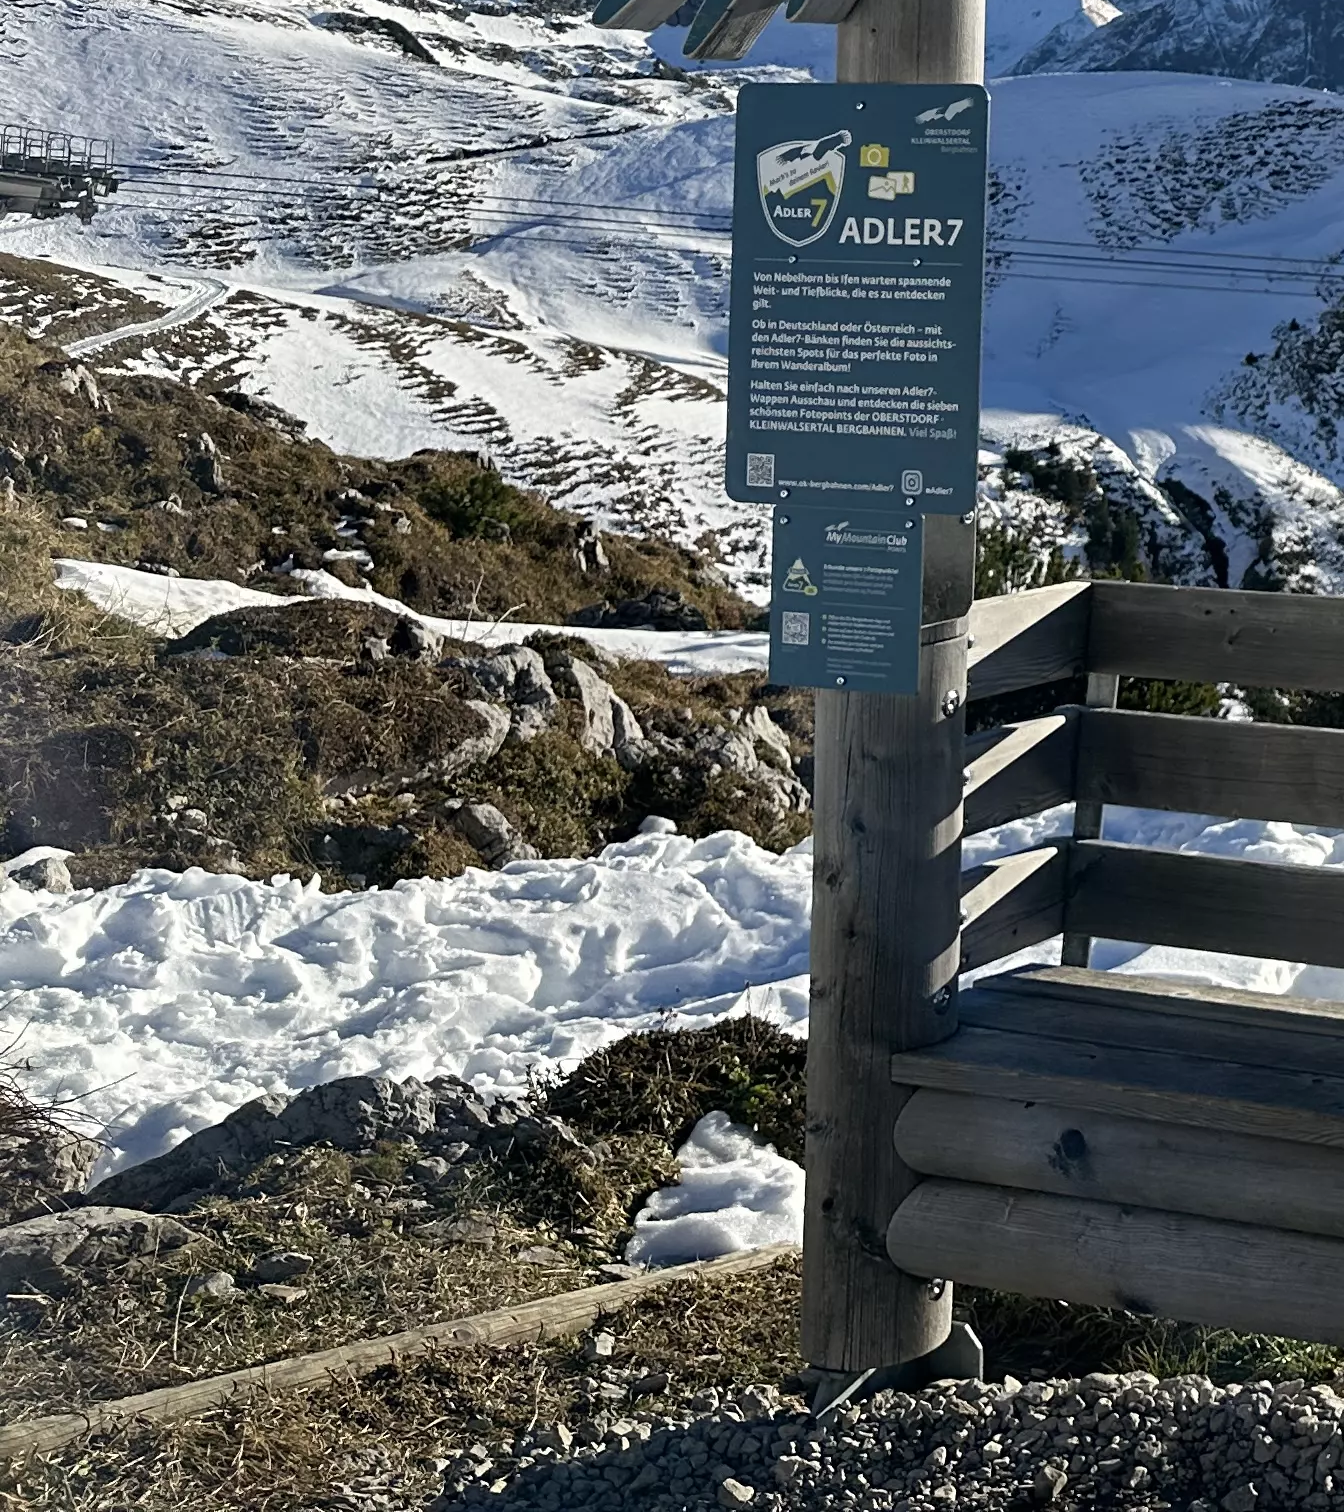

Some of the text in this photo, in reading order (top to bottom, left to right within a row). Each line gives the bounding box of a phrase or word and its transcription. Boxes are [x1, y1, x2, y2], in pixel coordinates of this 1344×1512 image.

[811, 199, 827, 227] 7
[753, 272, 952, 288] Von Nebelhorn bis Ifen warten spannende
[753, 285, 946, 300] Weit- und Tiefblicke, die es zu entdecken
[752, 298, 772, 310] gilt.
[752, 319, 766, 329] Ob
[768, 319, 776, 329] in
[778, 320, 838, 331] Deutschland
[840, 322, 862, 332] oder
[864, 320, 915, 334] Österreich
[924, 324, 942, 335] mit
[752, 332, 769, 342] den
[842, 335, 872, 346] finden
[874, 336, 888, 346] Sie
[890, 336, 905, 347] die
[906, 338, 956, 349] aussichts-
[752, 346, 938, 362] reichsten Spots für das perfekte Foto in
[751, 358, 851, 372] Ihrem Wanderalbum!
[750, 380, 937, 396] Halten Sie einfach nach unseren Adler7-
[750, 393, 959, 411] Wappen Ausschau und entdecken die sieben
[750, 406, 798, 417] schönsten
[800, 409, 852, 421] Fotopoints
[854, 411, 870, 420] der
[872, 412, 939, 424] OBERSTDORF
[750, 420, 957, 440] KLEINWALSERTAL BERGBAHNEN. Viel Spaß!
